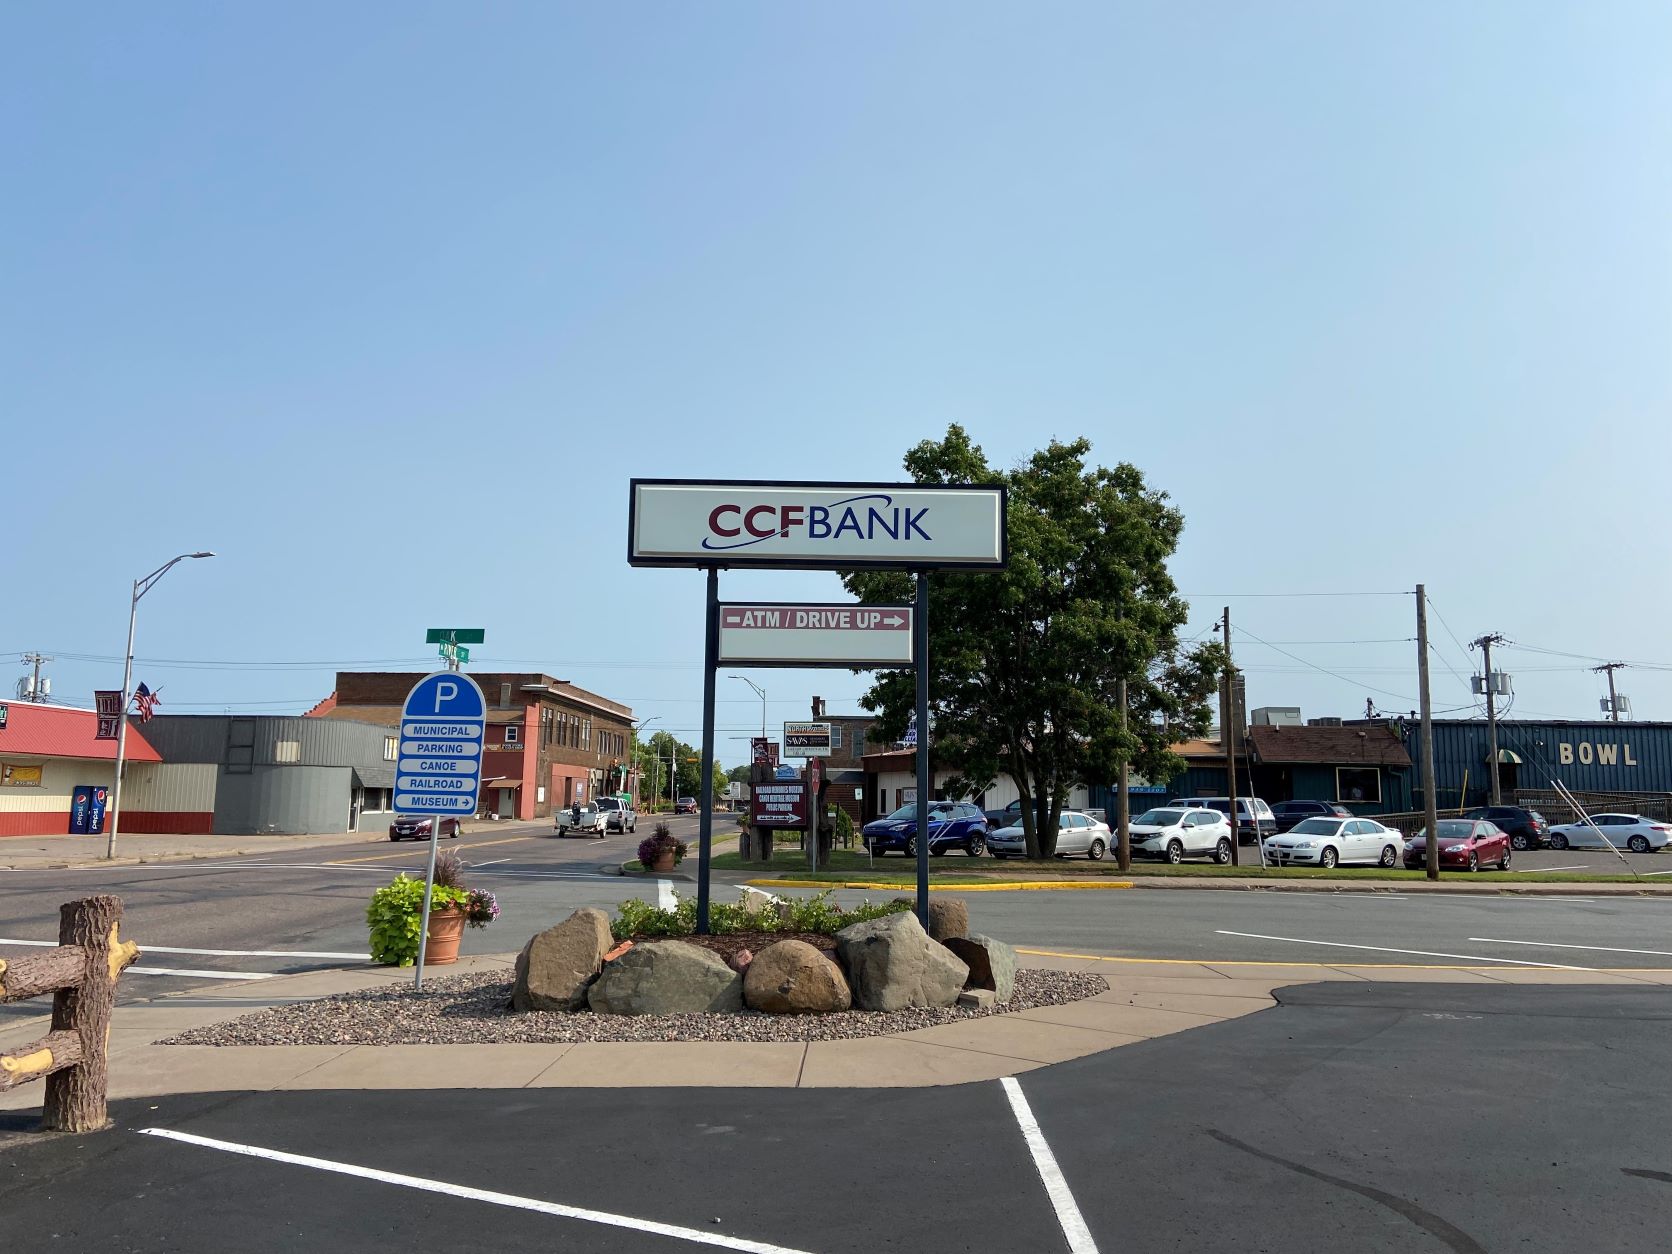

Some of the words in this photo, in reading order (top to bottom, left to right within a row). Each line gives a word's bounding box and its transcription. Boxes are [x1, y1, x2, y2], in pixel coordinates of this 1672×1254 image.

[741, 611, 780, 627] ATM
[796, 612, 850, 628] DRIVE
[856, 612, 881, 628] UP
[434, 682, 458, 713] P
[413, 726, 470, 736] MUNICIPAL
[417, 744, 463, 753] PARKING
[1559, 742, 1637, 765] BOWL
[420, 761, 457, 771] CANOE
[409, 779, 463, 789] RAILROAD
[411, 797, 458, 807] MUSEUM
[76, 805, 84, 826] pepsi
